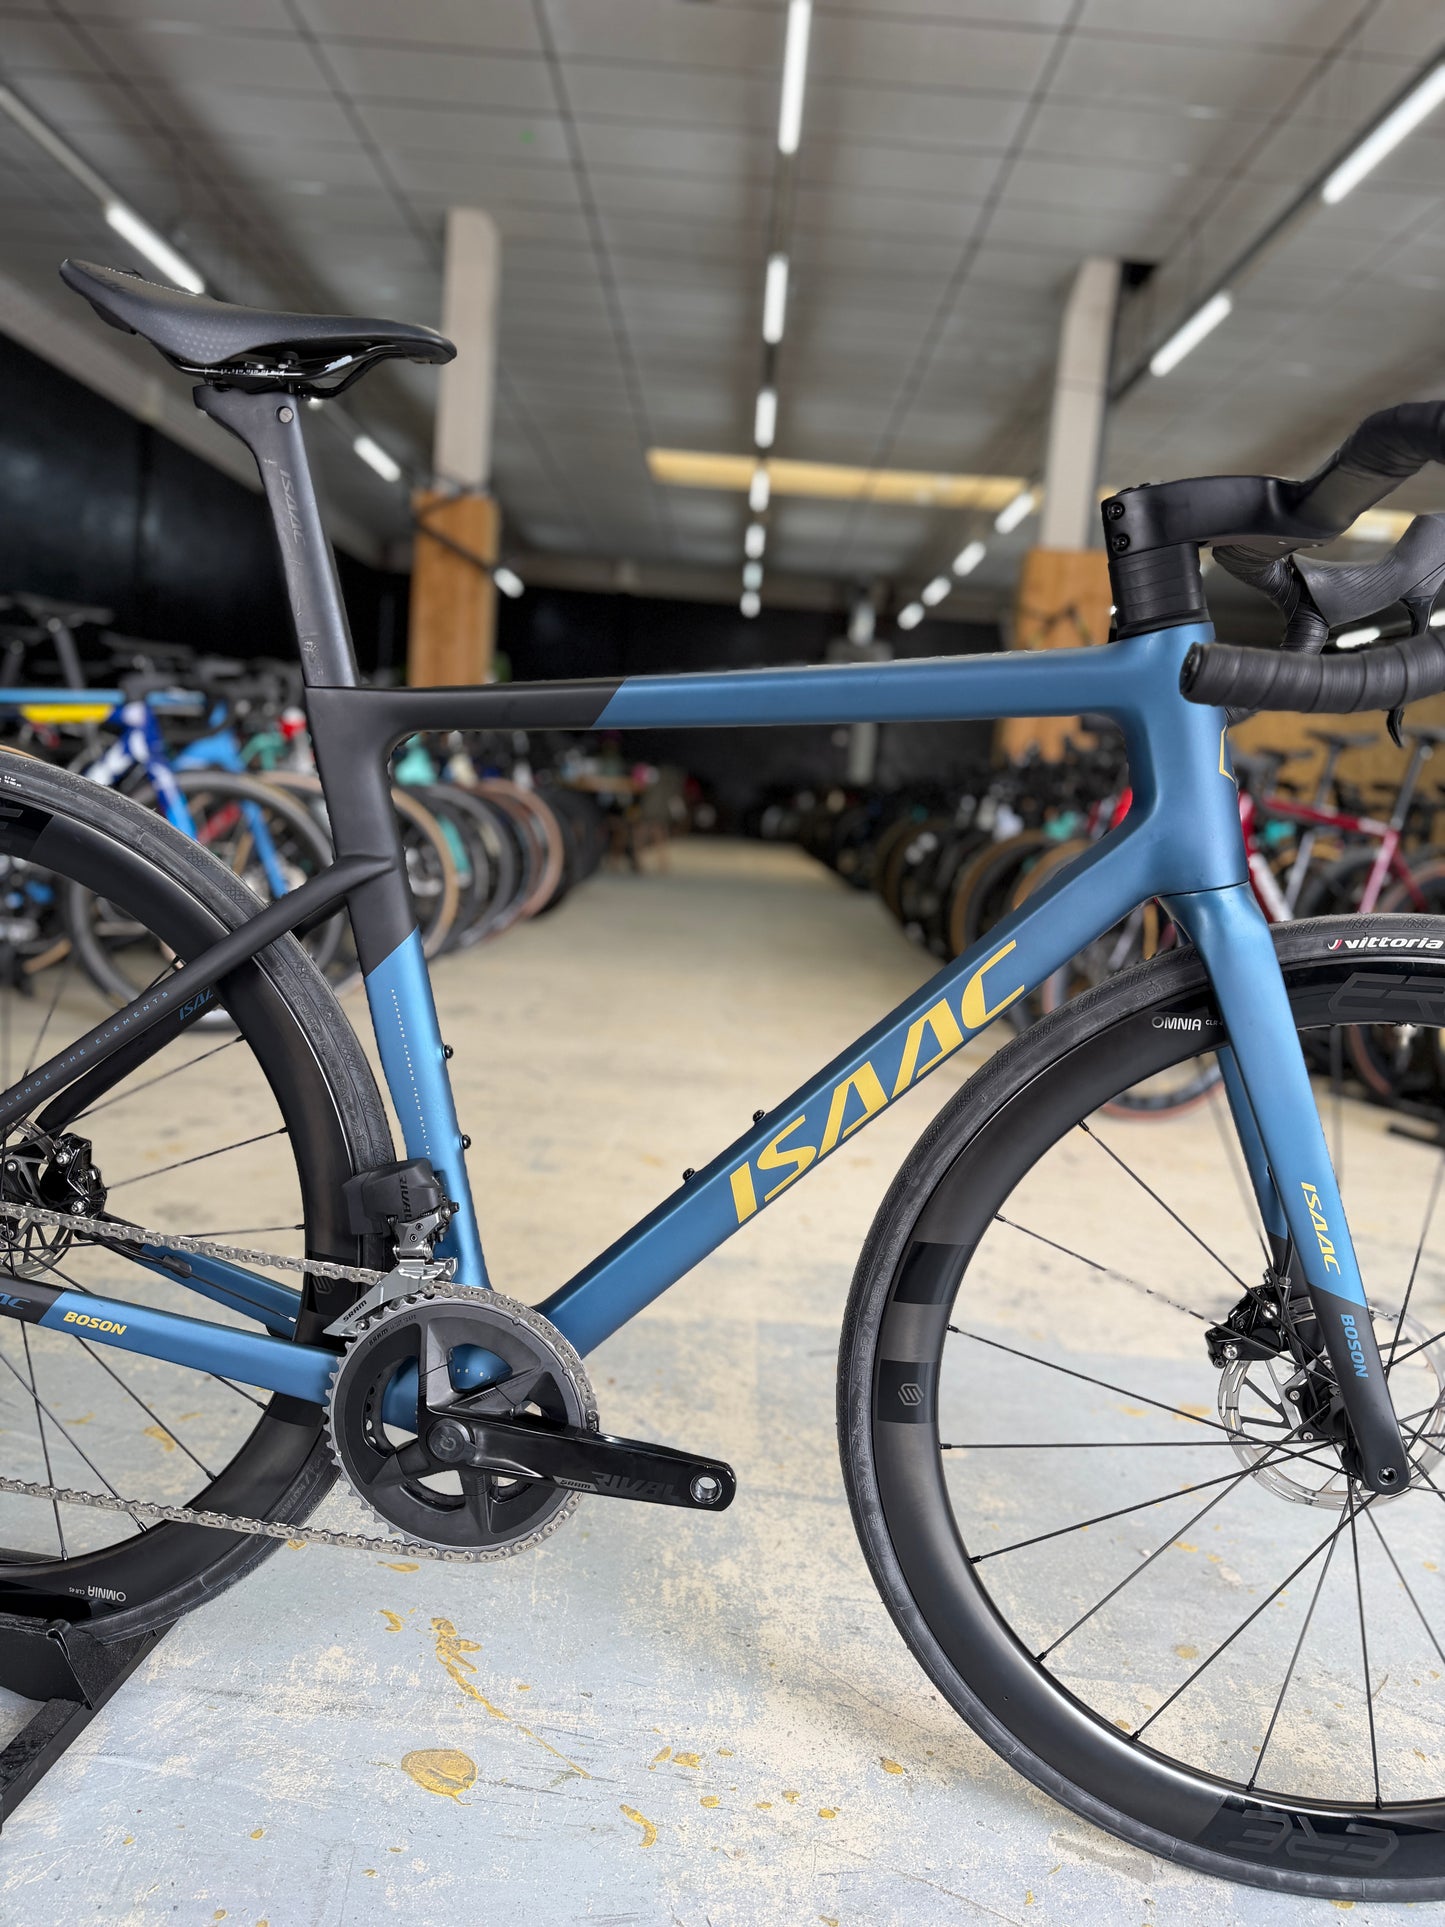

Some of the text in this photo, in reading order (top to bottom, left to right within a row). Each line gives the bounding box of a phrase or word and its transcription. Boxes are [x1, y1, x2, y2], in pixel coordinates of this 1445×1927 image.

[1345, 936, 1445, 949] vittoria
[60, 1048, 87, 1069] THE
[95, 990, 169, 1045] ELEMENTS
[1151, 1016, 1202, 1031] OMNIA
[729, 939, 1025, 1224] ISAAC
[1300, 1181, 1341, 1276] ISAAC
[63, 1310, 128, 1336] BOSON
[342, 1299, 369, 1323] SRAM
[1340, 1313, 1369, 1378] BOSON
[87, 1585, 126, 1602] OMNIA
